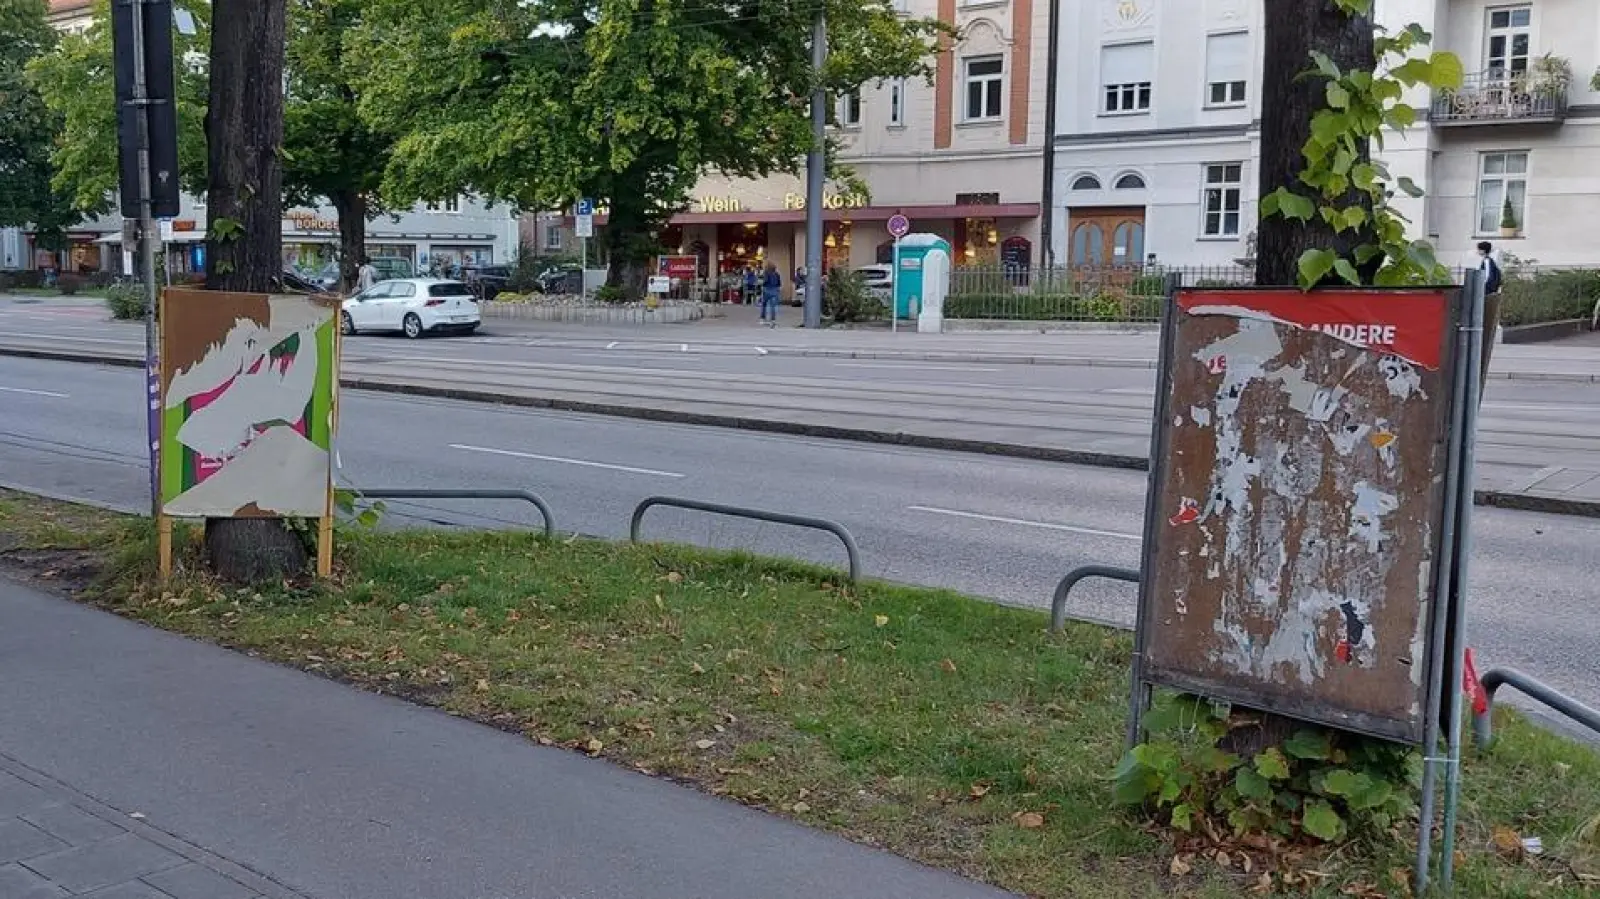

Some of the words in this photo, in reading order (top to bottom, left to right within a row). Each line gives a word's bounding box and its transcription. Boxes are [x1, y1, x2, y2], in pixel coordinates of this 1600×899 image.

[578, 199, 589, 213] P
[700, 195, 740, 212] Wein
[785, 190, 864, 211] Fekost
